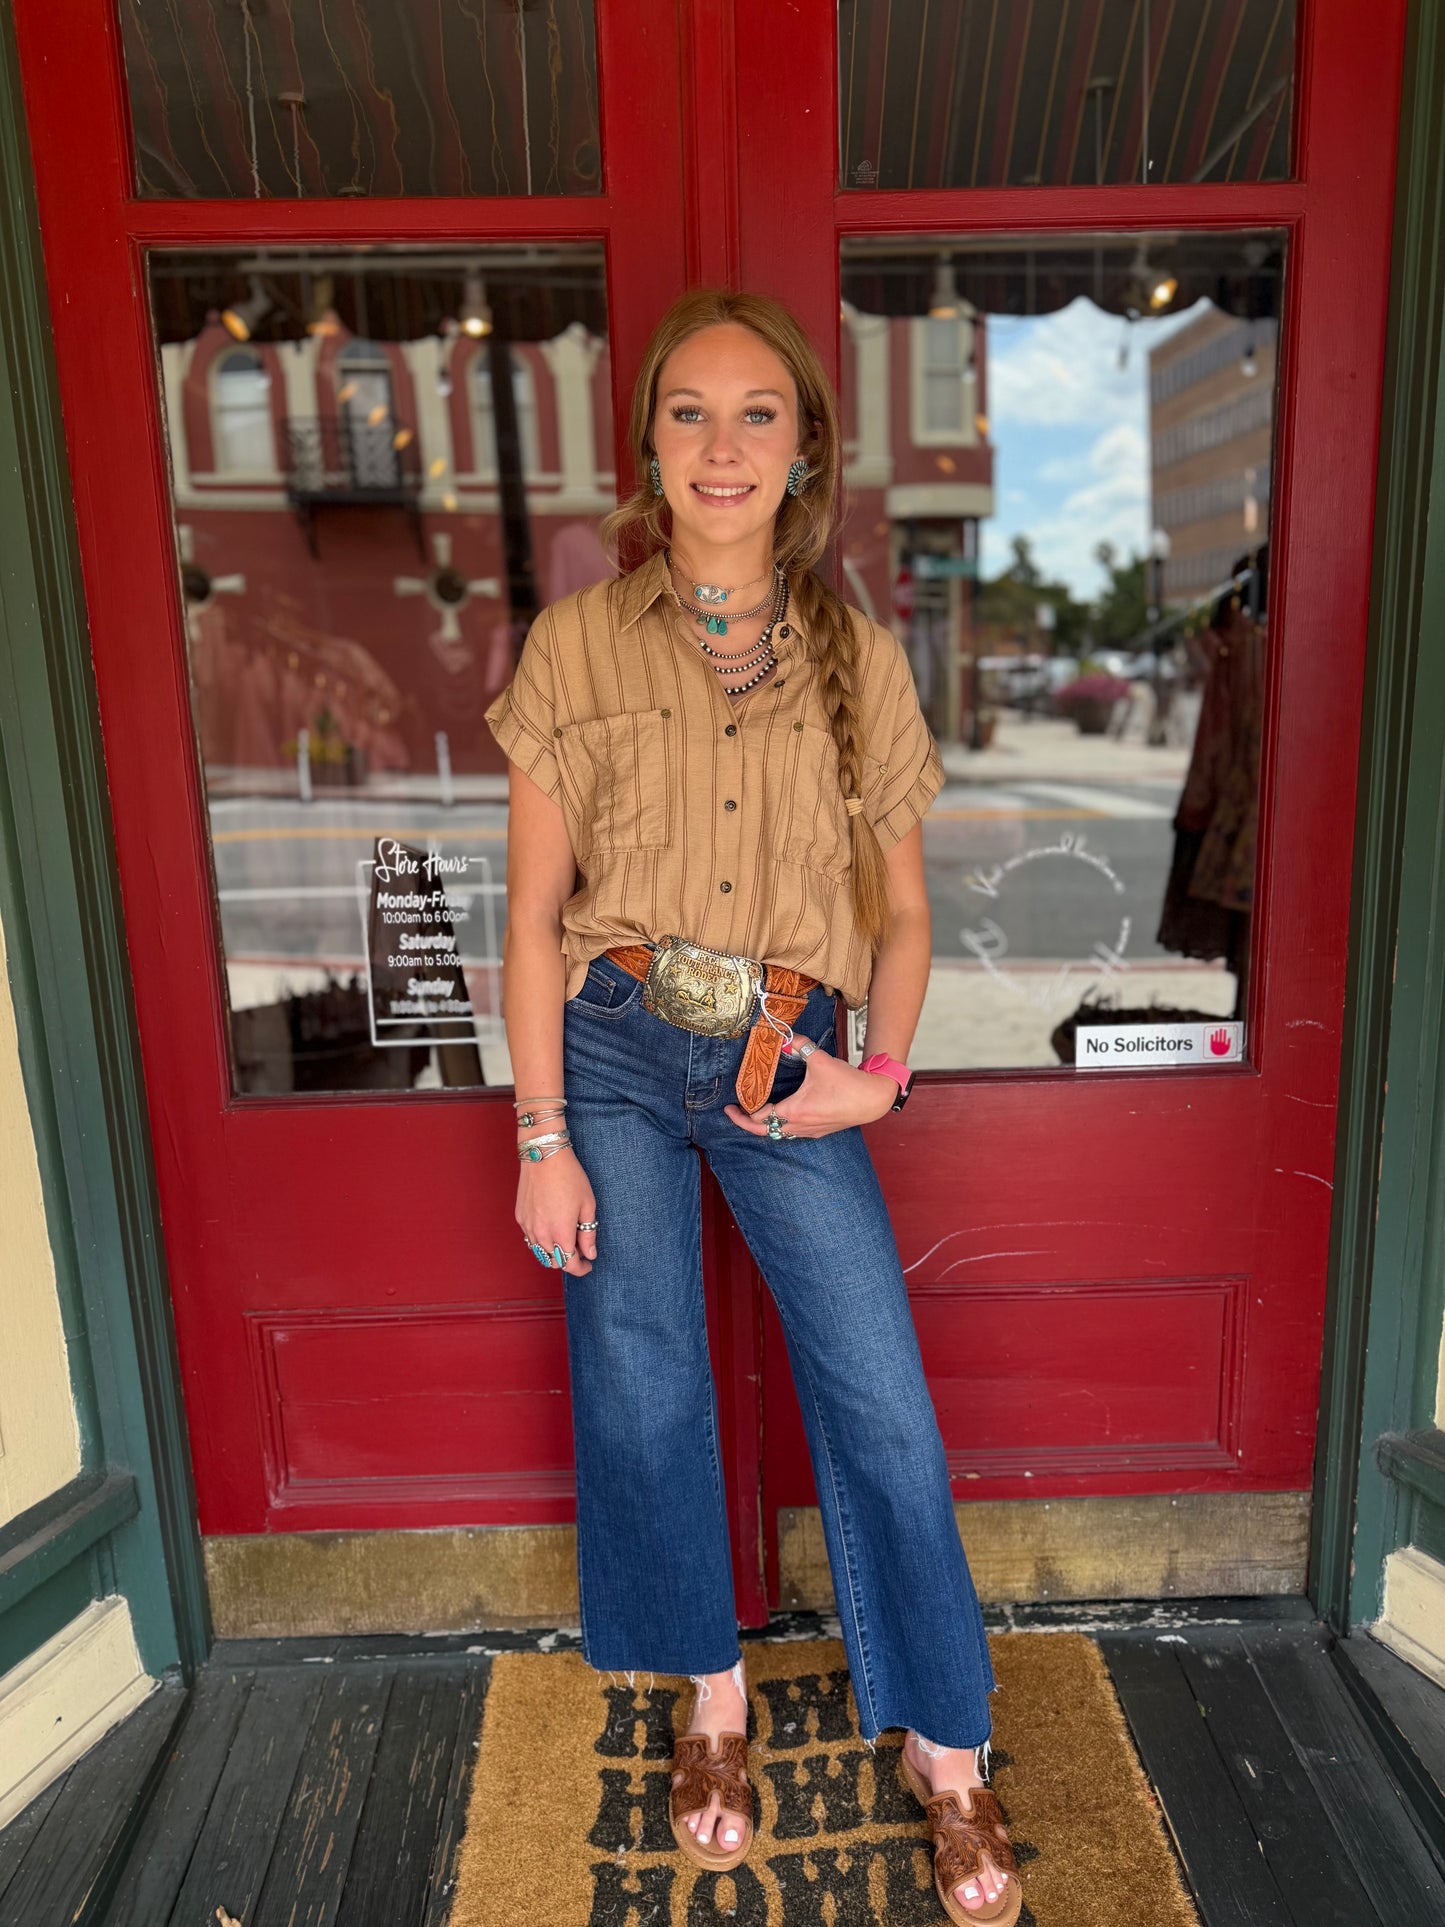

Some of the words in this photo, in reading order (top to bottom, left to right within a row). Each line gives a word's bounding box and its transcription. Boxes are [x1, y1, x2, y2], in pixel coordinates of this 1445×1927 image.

[375, 838, 420, 882] Store
[422, 850, 468, 882] Hours
[376, 890, 472, 911] Monday-Fri
[382, 911, 421, 924] 10:00am
[423, 911, 433, 923] to
[434, 910, 470, 923] 600pm
[399, 932, 456, 952] Saturday
[388, 955, 422, 967] 9:00am
[424, 955, 434, 966] to
[678, 953, 705, 970] YOUTH
[707, 964, 736, 980] RANCH
[688, 967, 719, 983] RODEO
[407, 977, 455, 998] Sunday
[1086, 1038, 1109, 1054] No
[1114, 1036, 1193, 1053] Solicitors
